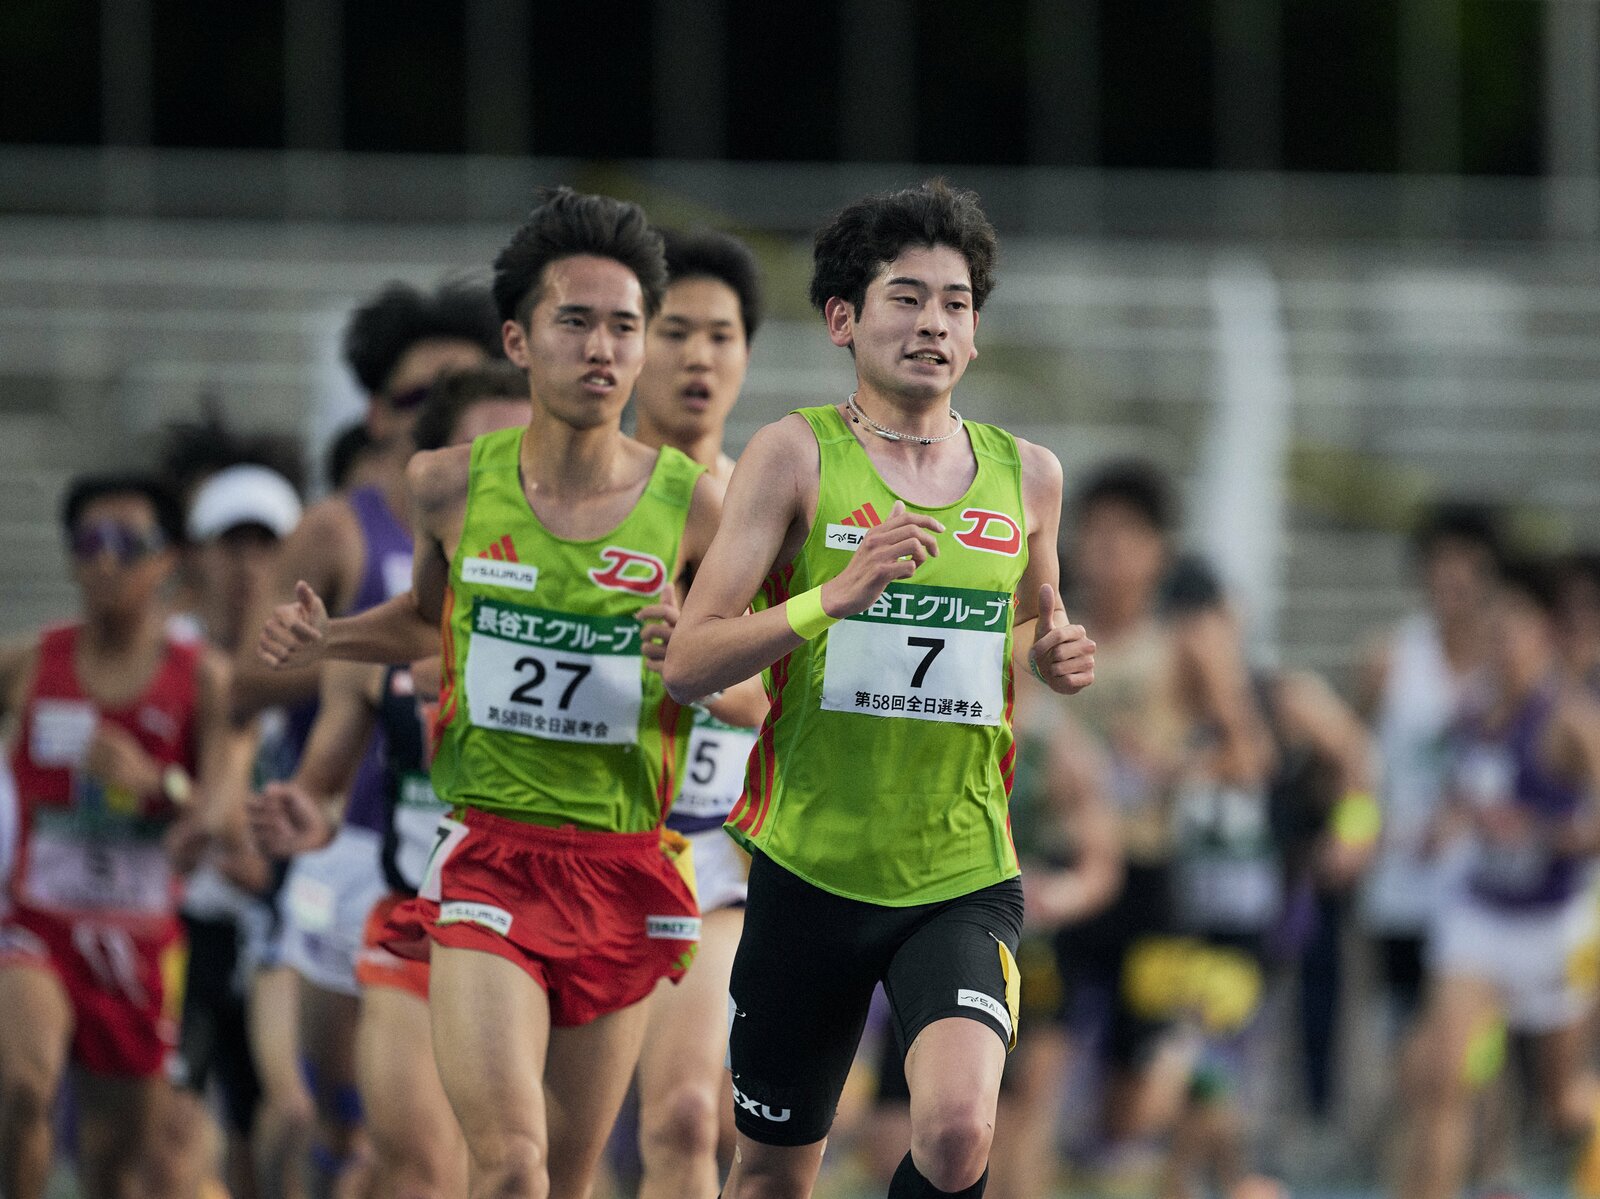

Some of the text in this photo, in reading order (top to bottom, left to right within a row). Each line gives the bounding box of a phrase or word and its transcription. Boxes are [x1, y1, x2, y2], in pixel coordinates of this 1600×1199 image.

[860, 592, 1008, 627] 谷工グループ
[509, 656, 593, 711] 27
[907, 636, 945, 689] 7
[854, 690, 983, 718] 第58回全日選考会
